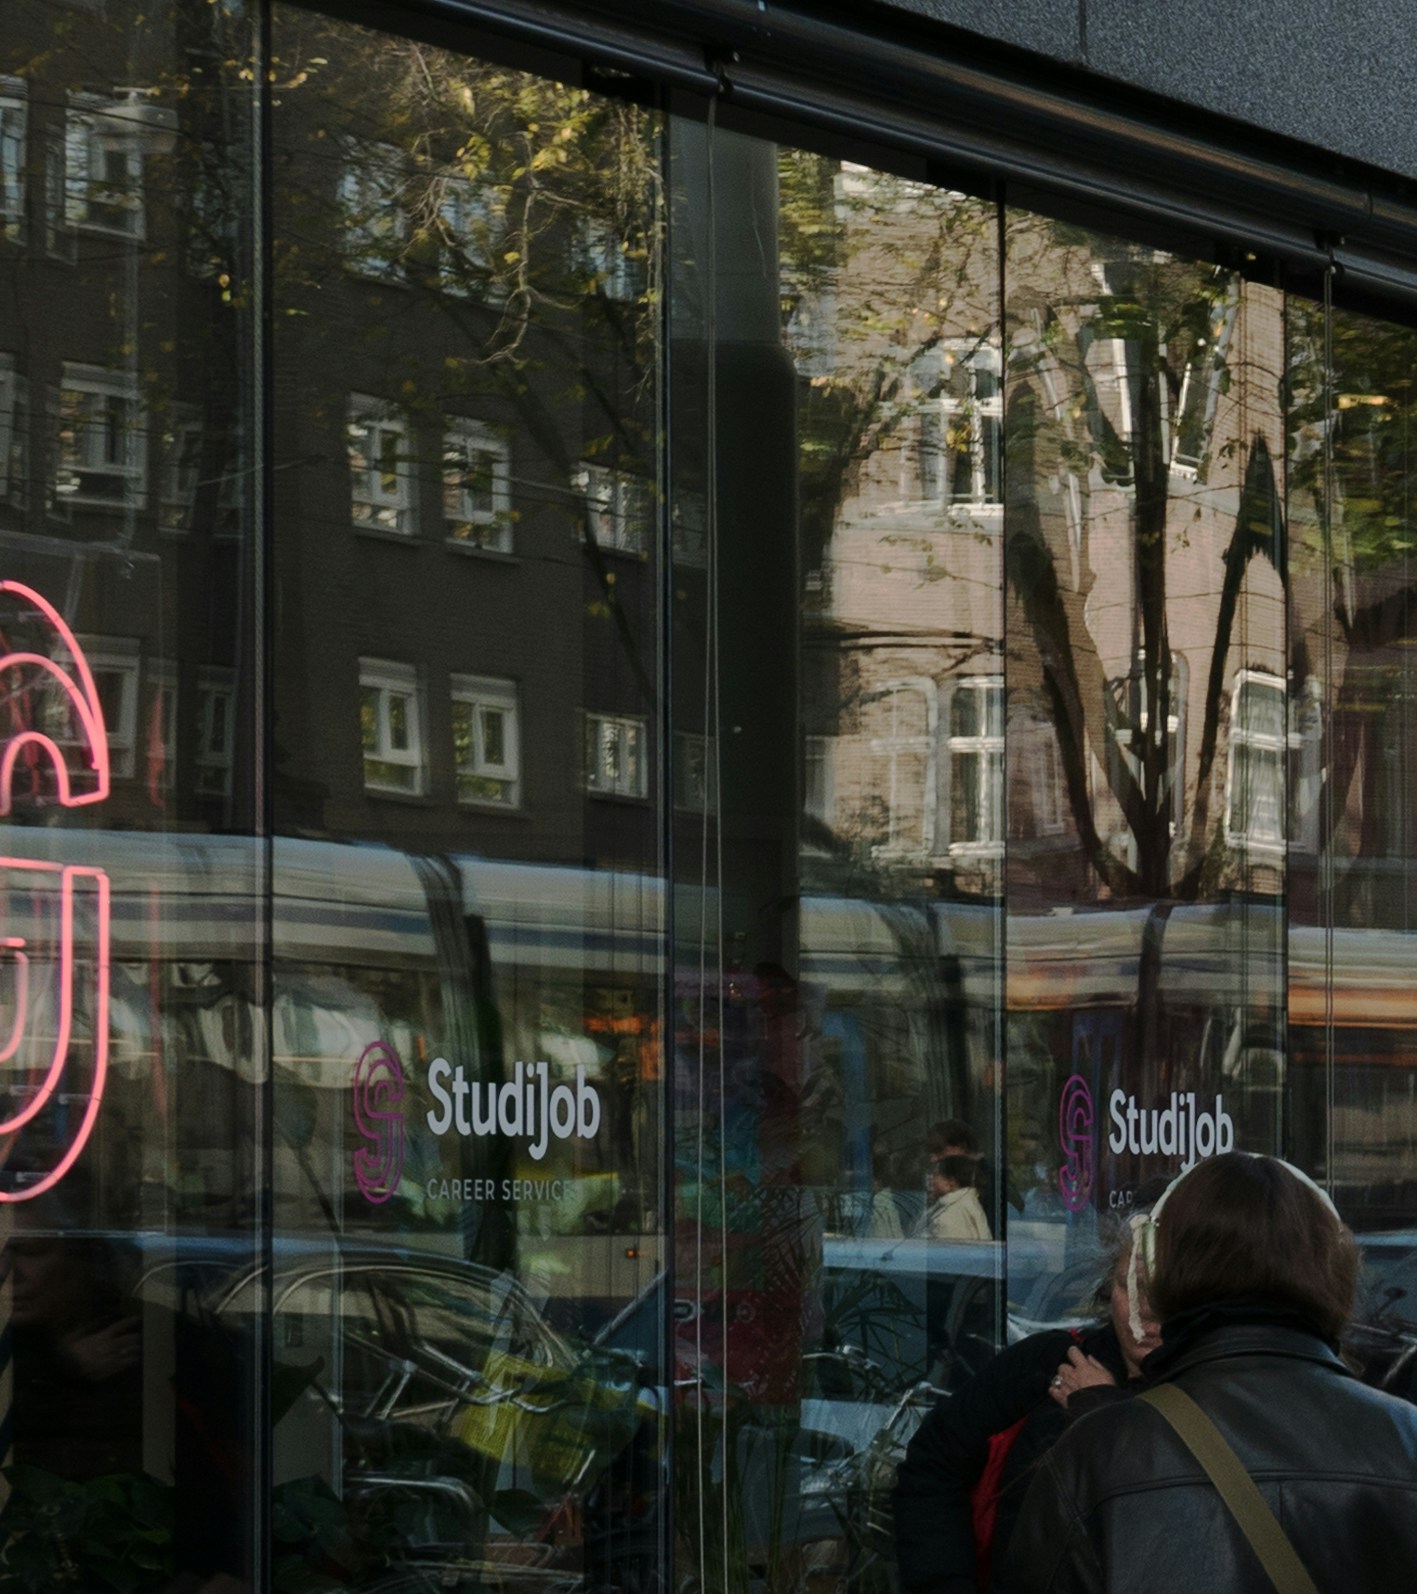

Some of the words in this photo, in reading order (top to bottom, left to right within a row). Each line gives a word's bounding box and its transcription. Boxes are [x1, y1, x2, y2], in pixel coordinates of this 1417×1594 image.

[425, 1057, 601, 1161] StudiJob
[1108, 1088, 1234, 1174] StudiJob
[426, 1178, 496, 1201] CAREER
